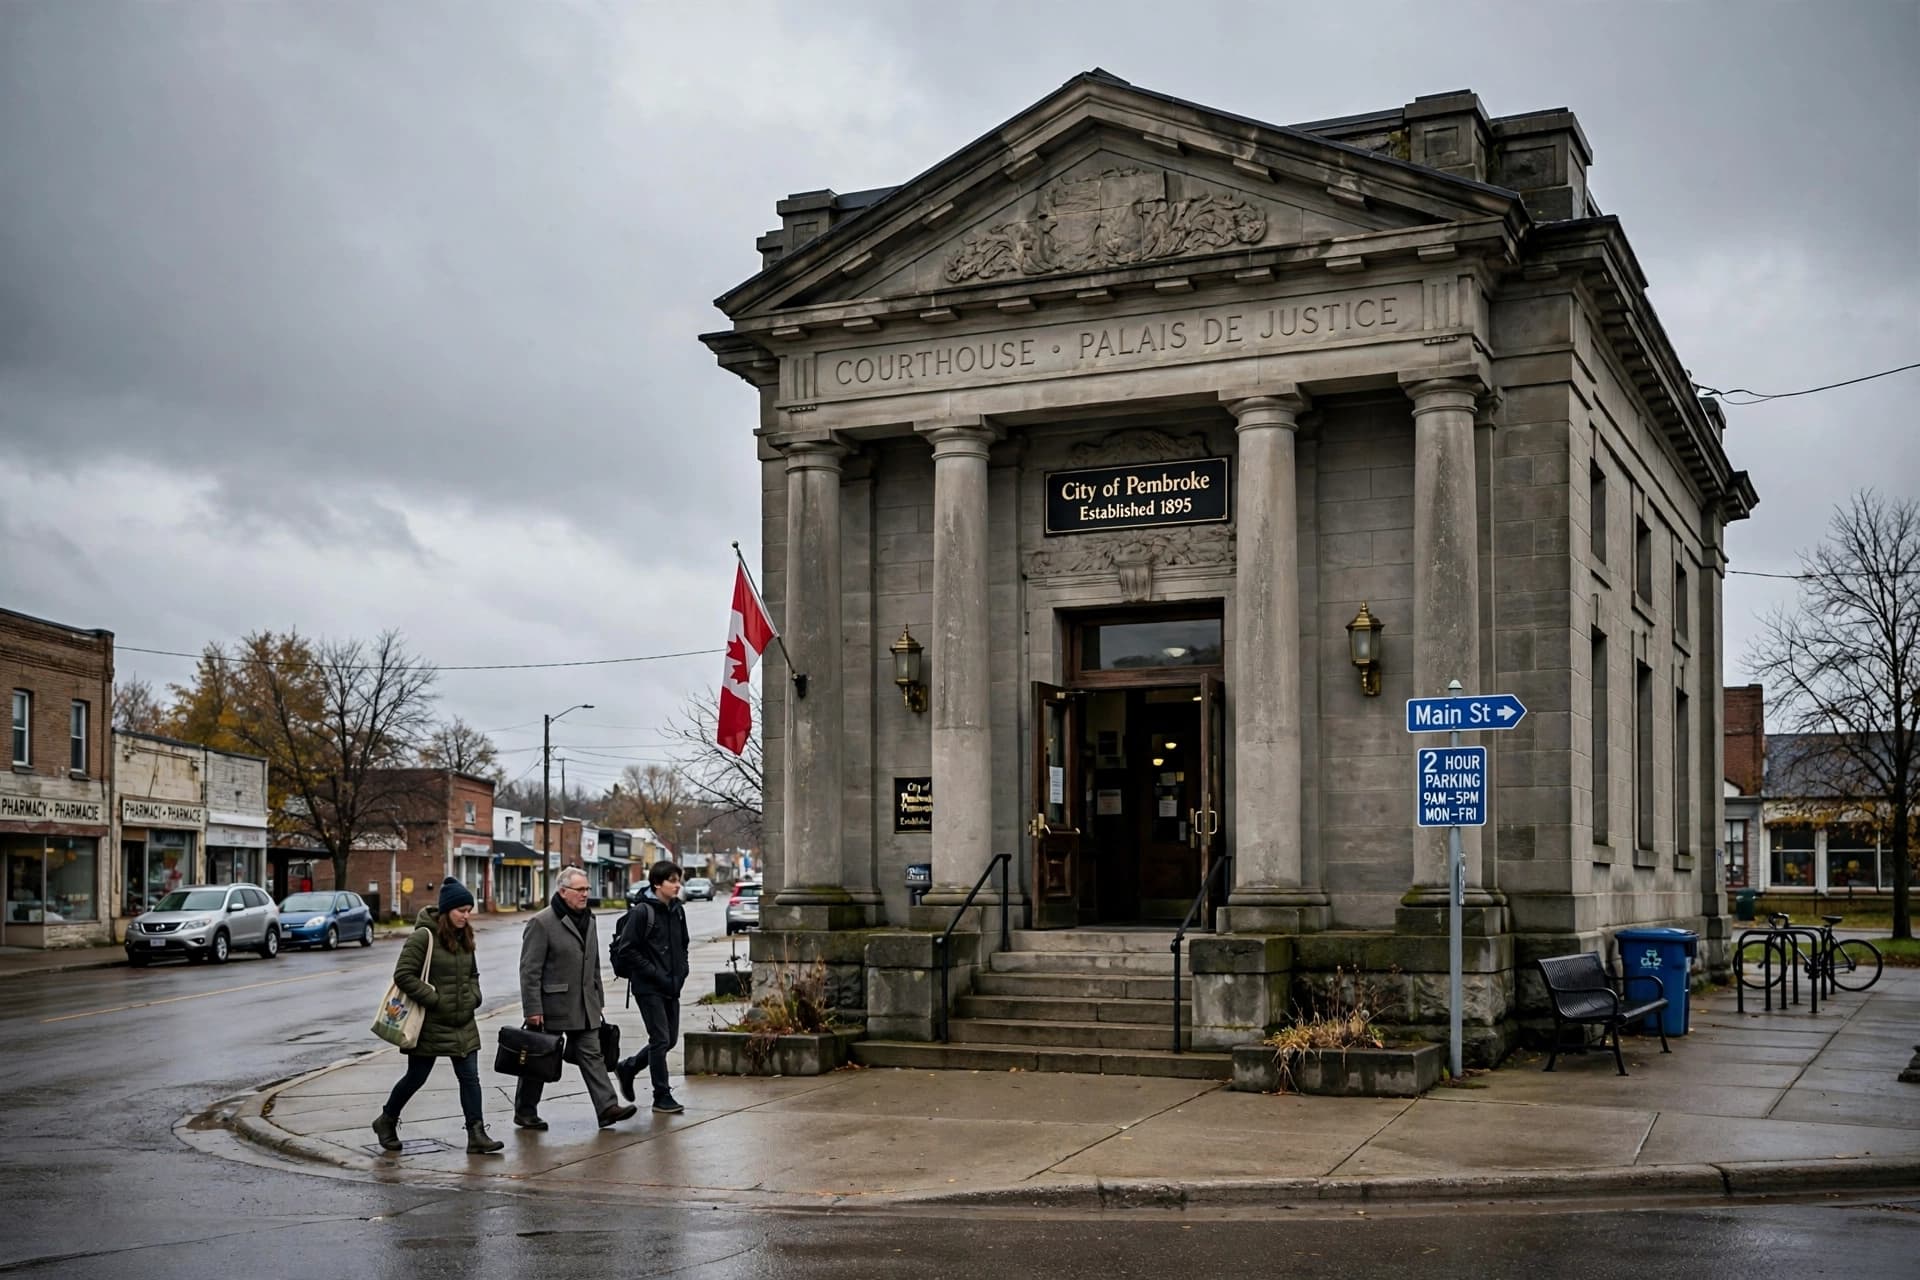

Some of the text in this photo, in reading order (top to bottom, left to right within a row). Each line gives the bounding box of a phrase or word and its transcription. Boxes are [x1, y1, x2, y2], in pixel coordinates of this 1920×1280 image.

[835, 297, 1397, 384] COURTHOUSE PALAIS DE JUSTICE
[1062, 470, 1210, 503] City of Pembroke
[1080, 497, 1192, 520] Established 1895
[1415, 702, 1491, 725] Main St
[1423, 751, 1480, 773] 2 HOUR
[1425, 773, 1480, 788] PARKING
[1, 798, 48, 817] PHARMACY
[1424, 791, 1479, 805] 9AM-5PM
[1425, 807, 1477, 821] MON-FRI
